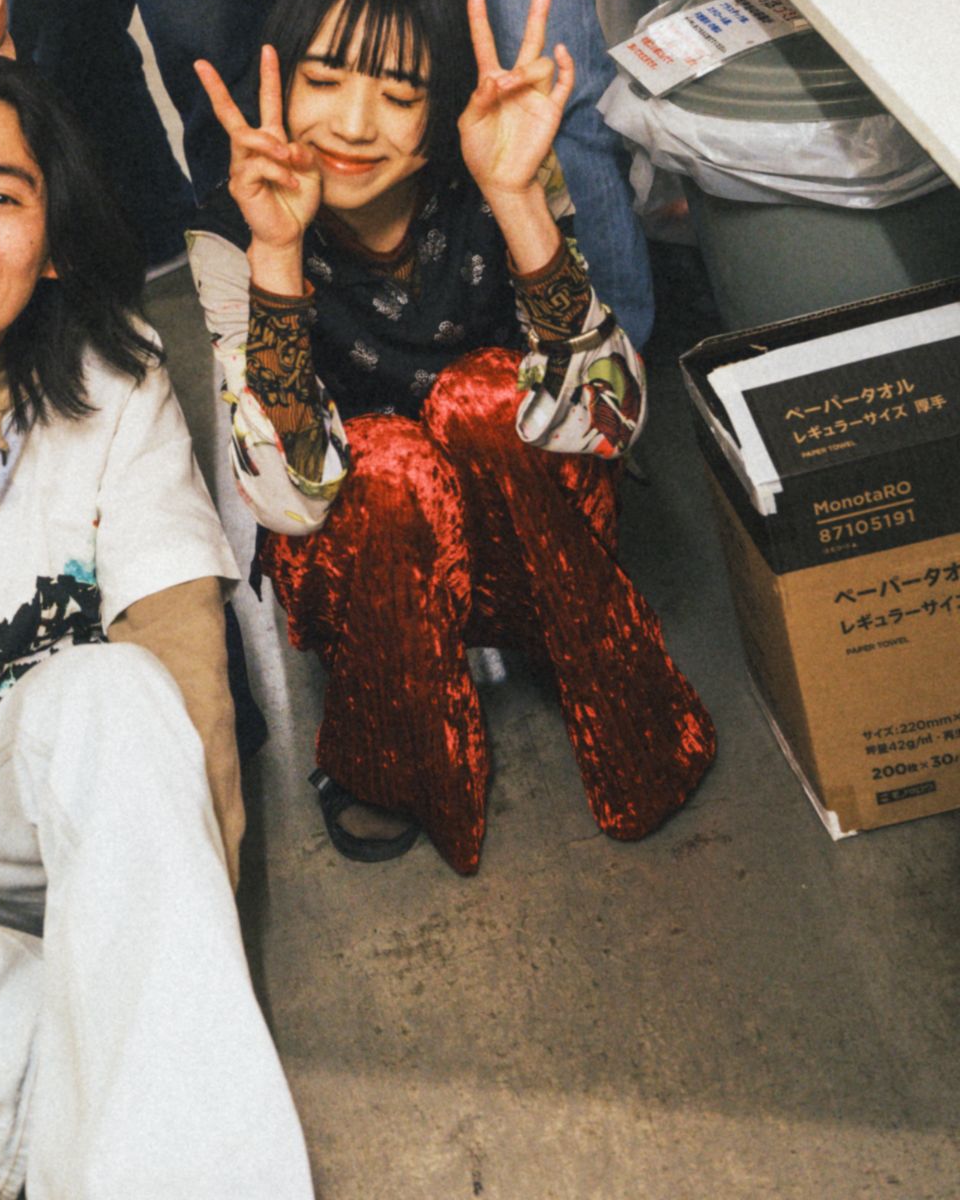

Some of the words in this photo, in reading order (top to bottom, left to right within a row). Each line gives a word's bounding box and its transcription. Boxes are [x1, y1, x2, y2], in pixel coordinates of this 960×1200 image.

[785, 378, 915, 420] ペーパータオル
[793, 404, 908, 444] レギュラーサイズ
[801, 446, 826, 458] PAPER
[827, 440, 856, 452] TOWEL
[813, 480, 912, 516] MonotaRO
[819, 508, 916, 543] 87105191
[846, 643, 875, 656] PAPER
[877, 637, 909, 649] TOWEL
